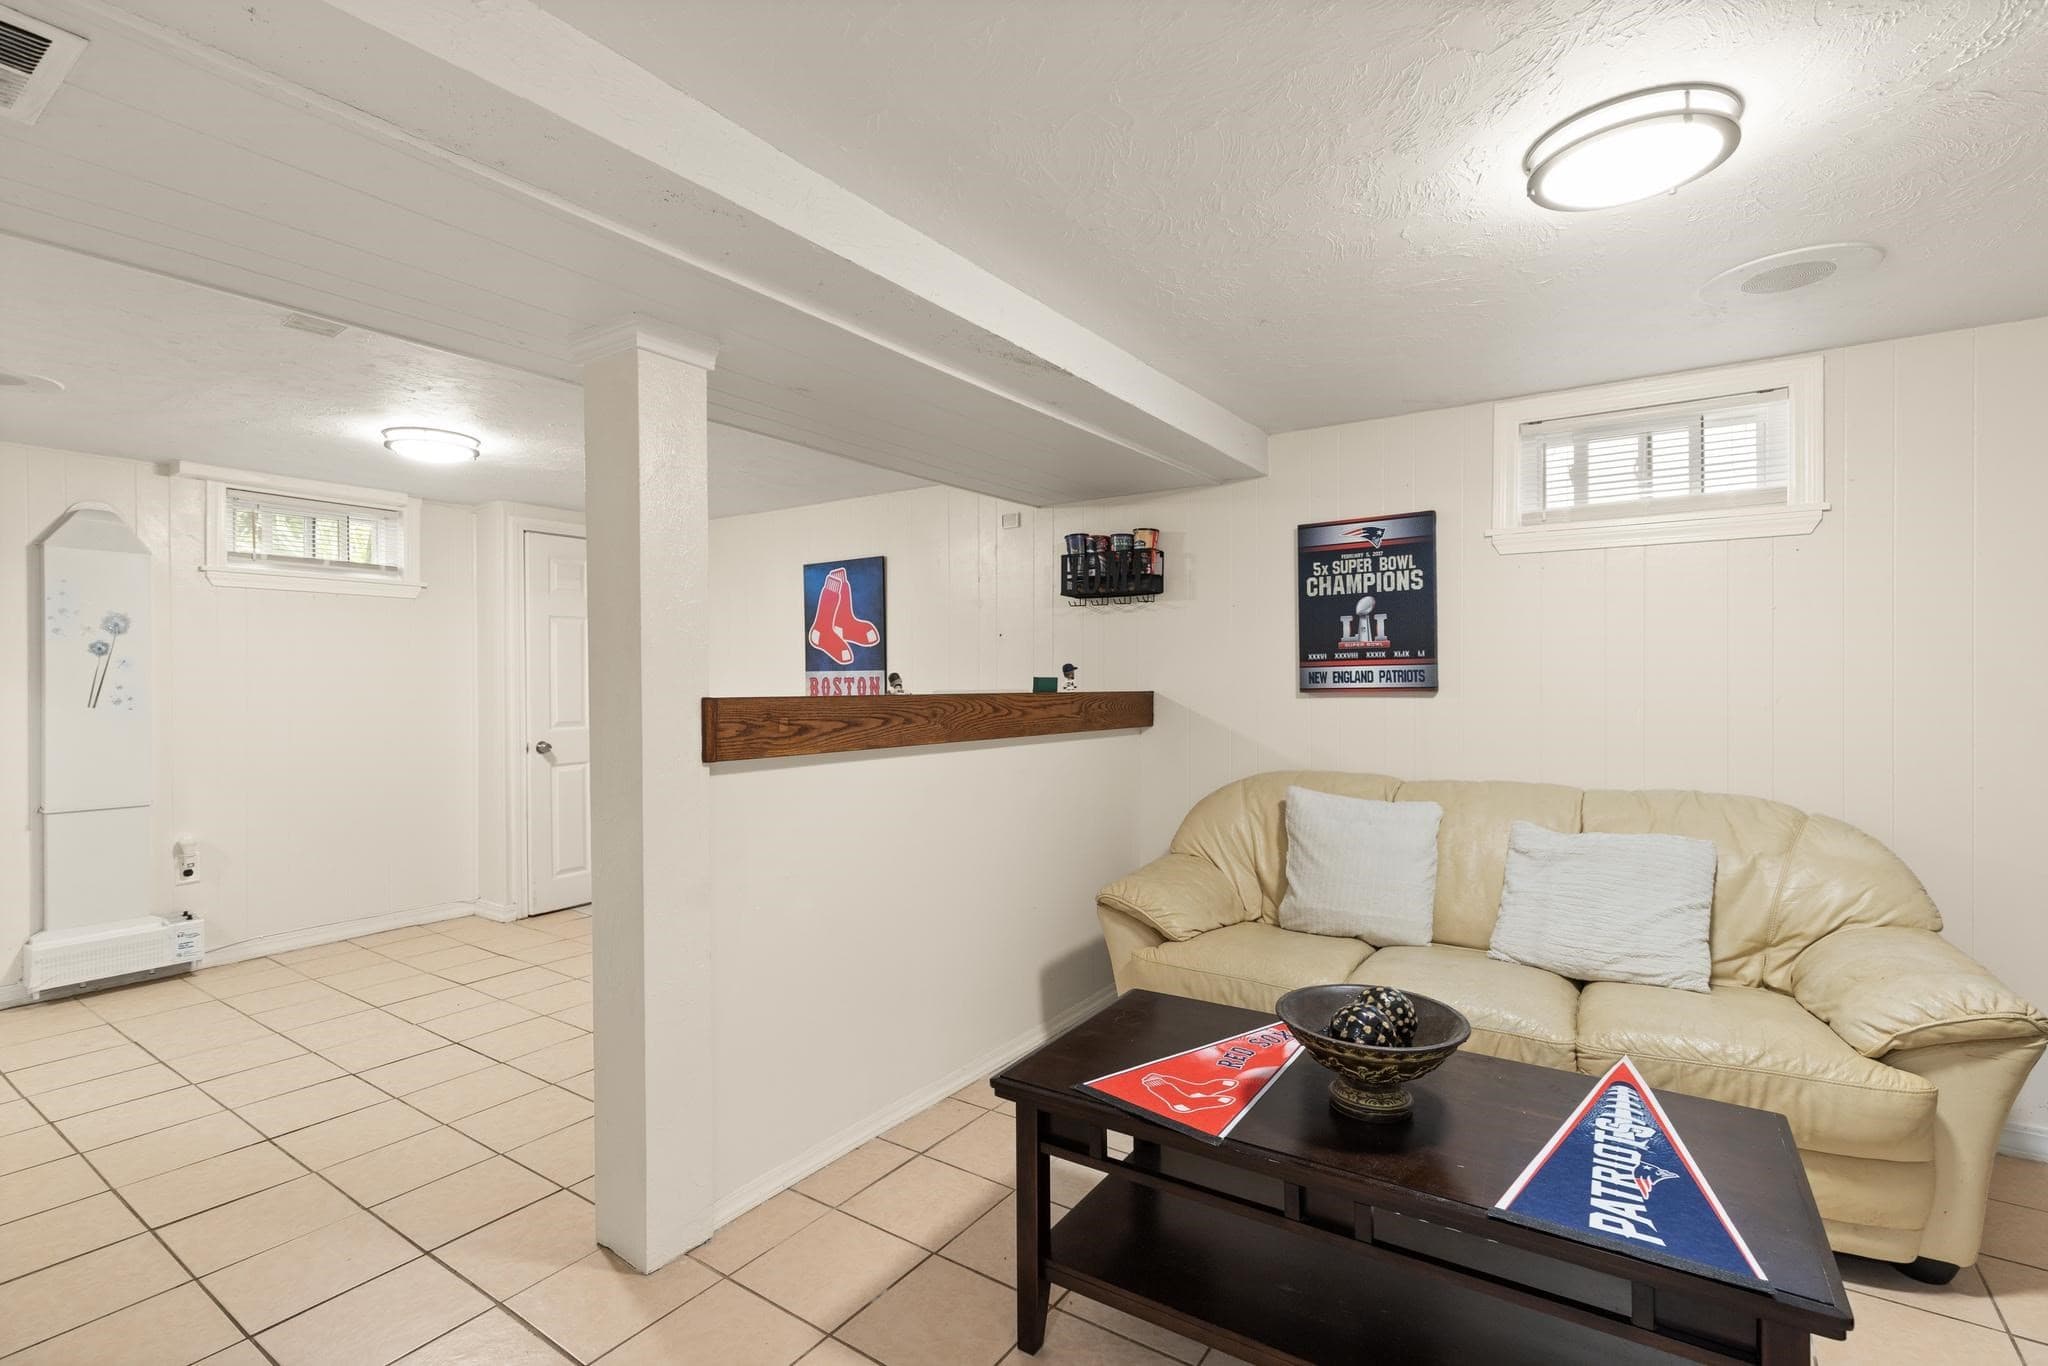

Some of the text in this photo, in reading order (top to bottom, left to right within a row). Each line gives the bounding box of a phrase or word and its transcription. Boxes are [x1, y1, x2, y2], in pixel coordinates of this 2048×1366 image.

[1313, 554, 1416, 576] 5x SUPER BOWL
[1306, 569, 1424, 597] CHAMPIONS
[809, 676, 880, 696] BOSTON
[1309, 669, 1425, 684] NEW ENGLAND PATRIOTS
[1216, 1030, 1292, 1070] RED SOX
[1589, 1116, 1667, 1247] PATRIOTS
